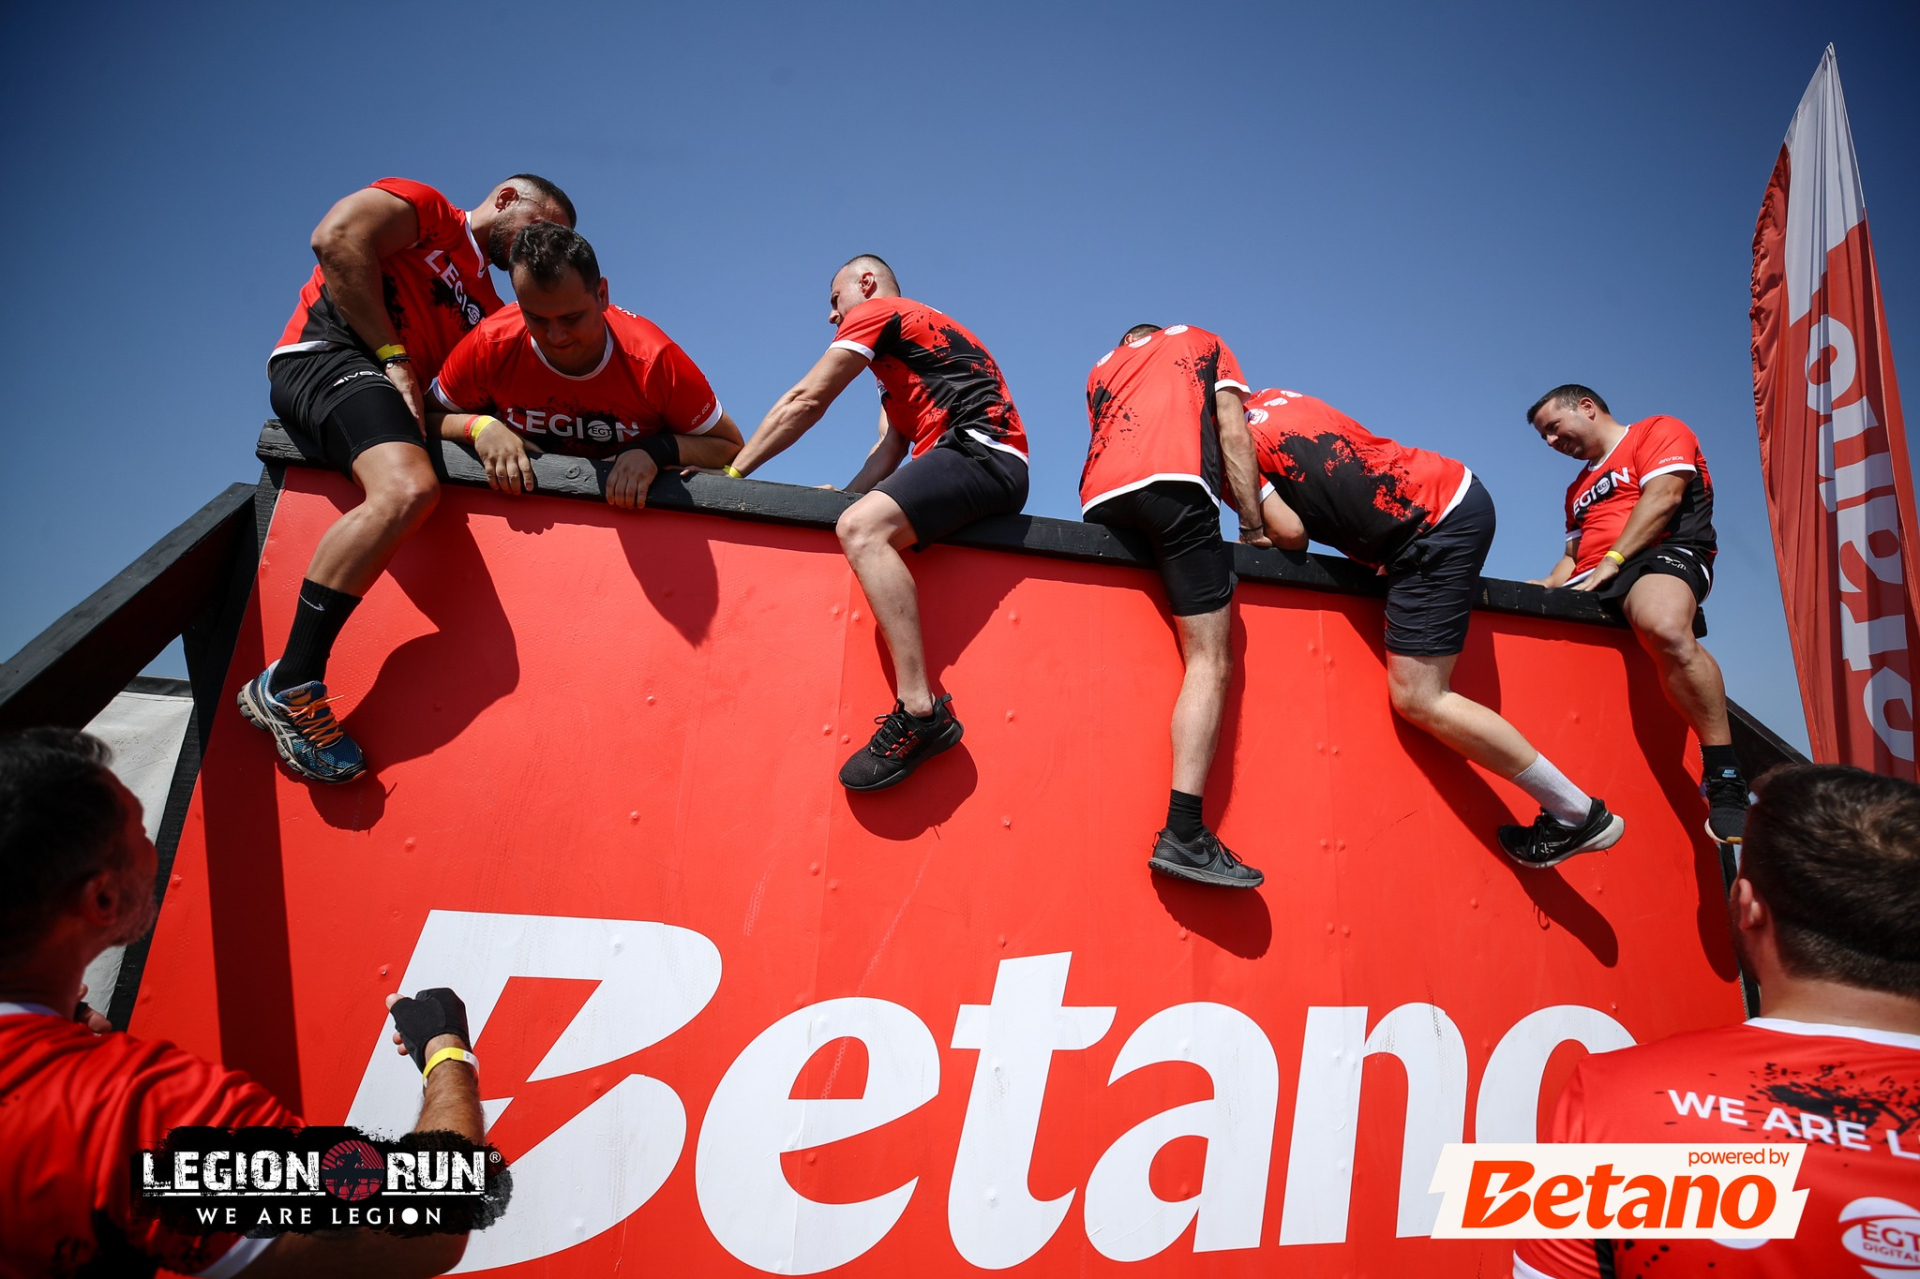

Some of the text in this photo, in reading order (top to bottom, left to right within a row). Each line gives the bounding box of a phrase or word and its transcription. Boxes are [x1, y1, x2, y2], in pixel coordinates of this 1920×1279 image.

[424, 250, 485, 325] LEGIO
[507, 407, 640, 442] LEGION
[1573, 467, 1630, 517] EGION
[1804, 314, 1914, 762] etano
[1667, 1089, 1920, 1161] WE ARE L
[1861, 1222, 1920, 1252] EGT
